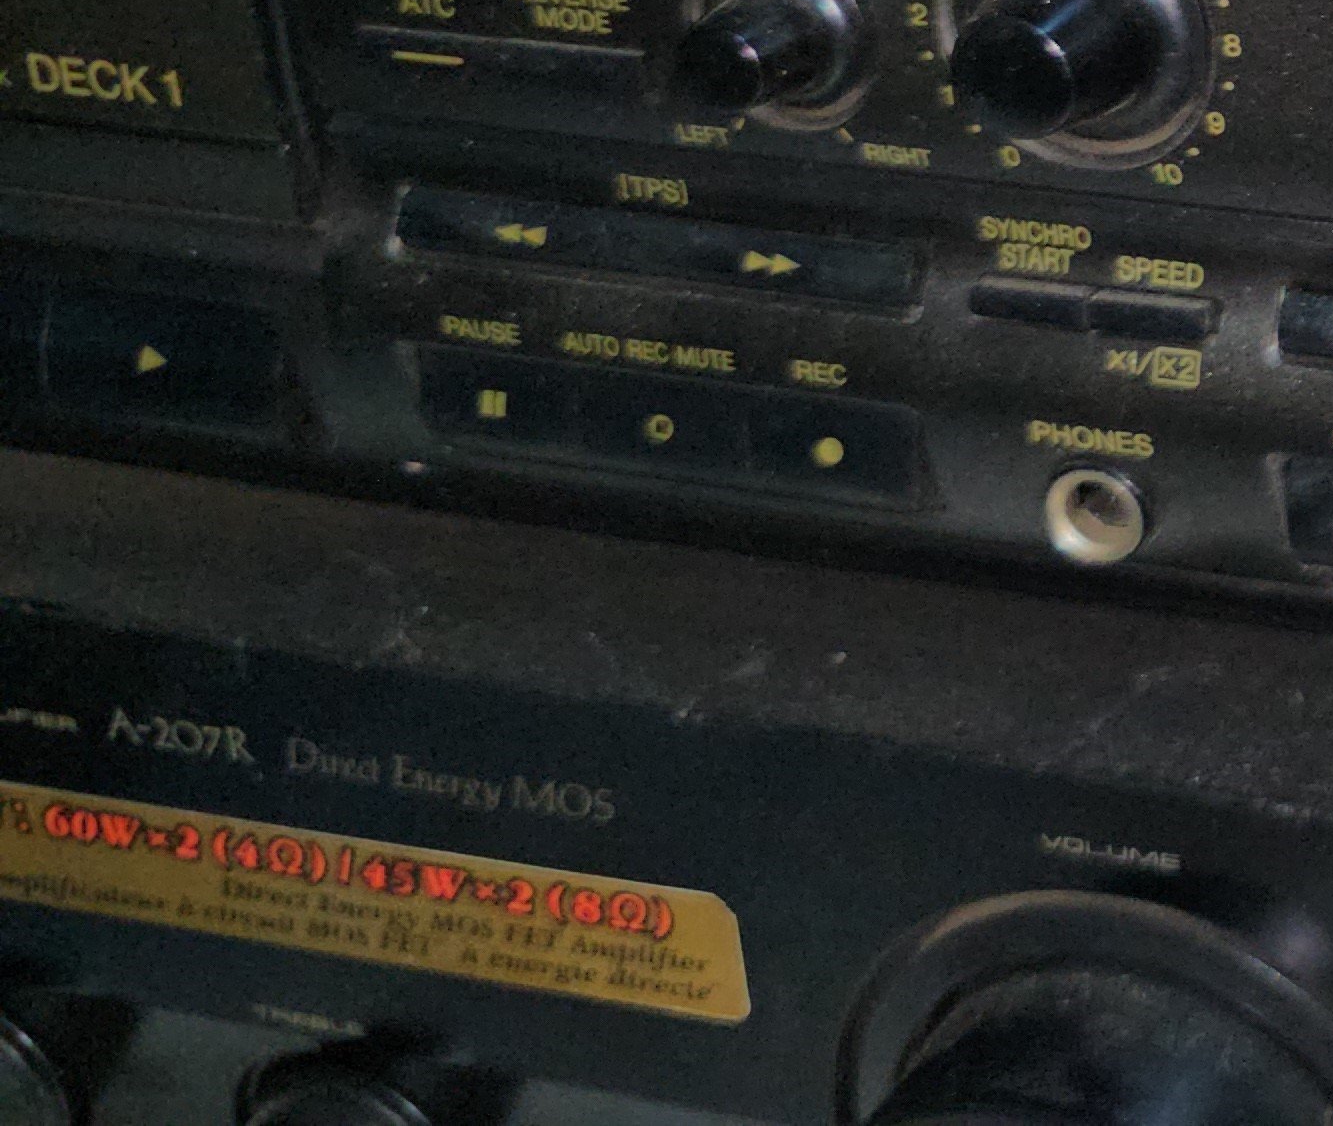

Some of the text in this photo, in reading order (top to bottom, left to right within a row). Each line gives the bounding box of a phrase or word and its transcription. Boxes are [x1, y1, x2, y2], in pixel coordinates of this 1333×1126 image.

[534, 8, 612, 34] MODE
[910, 4, 928, 26] 2
[1221, 34, 1242, 58] 8
[25, 51, 158, 105] DECK
[161, 70, 184, 108] 1
[940, 85, 955, 106] 1
[675, 123, 730, 148] LEFT
[1205, 111, 1226, 136] 9
[864, 142, 932, 168] RIGHT
[1001, 145, 1021, 168] 0
[1151, 162, 1183, 186] 10
[619, 173, 688, 206] [TPS]
[979, 216, 1092, 251] SYNCHRO
[999, 243, 1075, 275] START
[1114, 255, 1205, 289] SPEED
[441, 315, 521, 346] PAUSE
[562, 331, 736, 373] AUTO REC MUTE
[792, 360, 848, 387] REC
[1029, 419, 1154, 458] PHONES
[107, 706, 255, 763] A-207R
[288, 736, 380, 782] Direct
[392, 754, 500, 811] Energy
[511, 774, 616, 823] MOS
[1040, 833, 1181, 872] VOLUME
[431, 910, 493, 939] MOS
